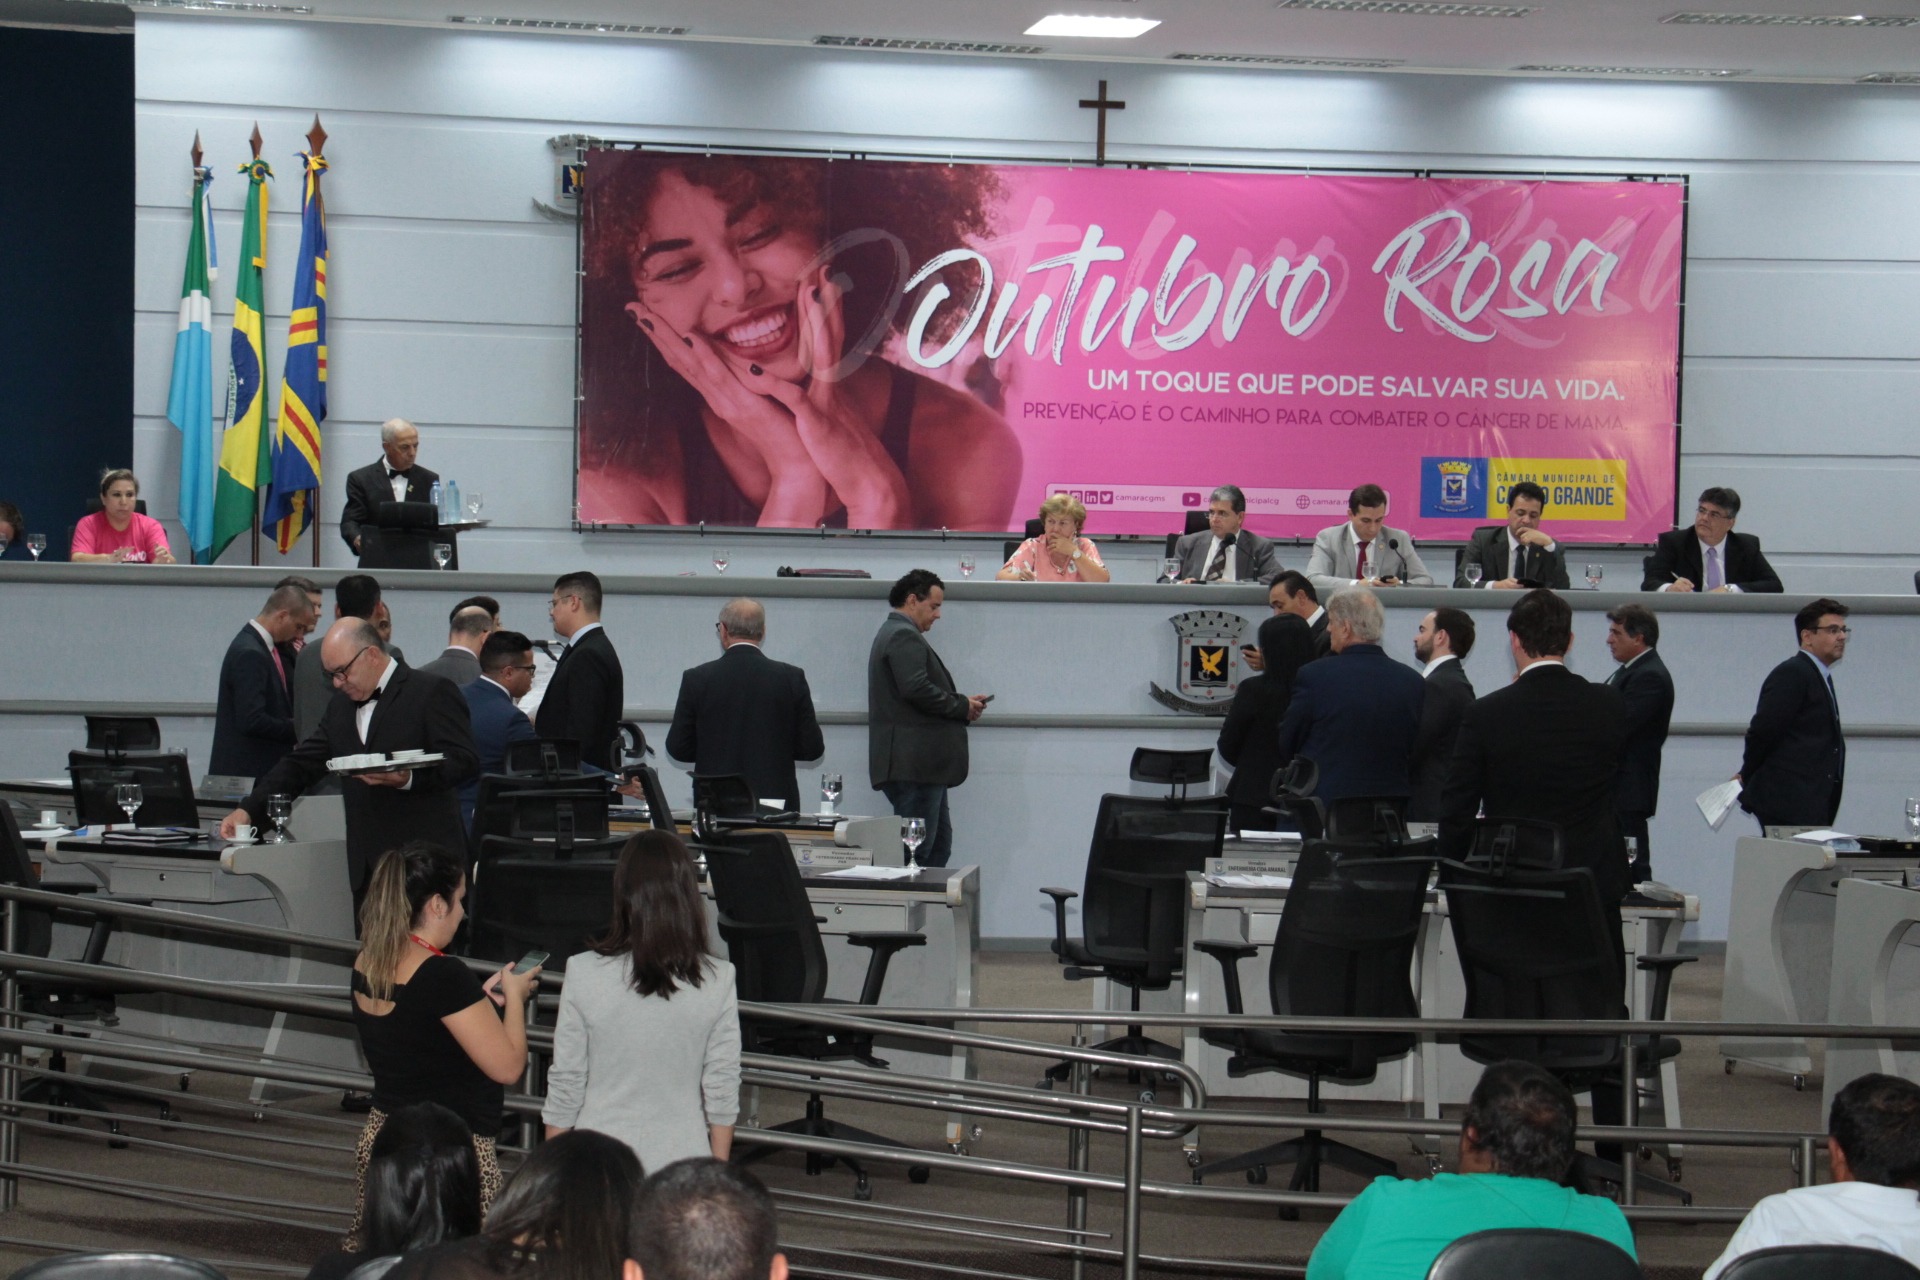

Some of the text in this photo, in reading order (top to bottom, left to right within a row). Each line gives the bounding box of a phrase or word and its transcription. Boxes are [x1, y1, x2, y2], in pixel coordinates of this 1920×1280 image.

[903, 209, 1619, 368] Outubro Rosa
[1088, 369, 1625, 401] UM TOQUE QUE PODE SALVAR SUA VIDA.
[1023, 401, 1137, 425] PREVENÇÃO
[1142, 401, 1153, 422] É
[1157, 405, 1174, 422] O
[1180, 406, 1271, 425] CAMINHO
[1276, 408, 1323, 426] PARA
[1329, 409, 1428, 428] COMBATER
[1433, 411, 1450, 428] O
[1536, 412, 1558, 431] DE
[1565, 414, 1629, 432] MAMA.
[1496, 473, 1615, 484] CÂMARA MUNICIPAL DE
[1115, 494, 1166, 503] camaracgms
[1496, 485, 1615, 506] CAO GRANDE
